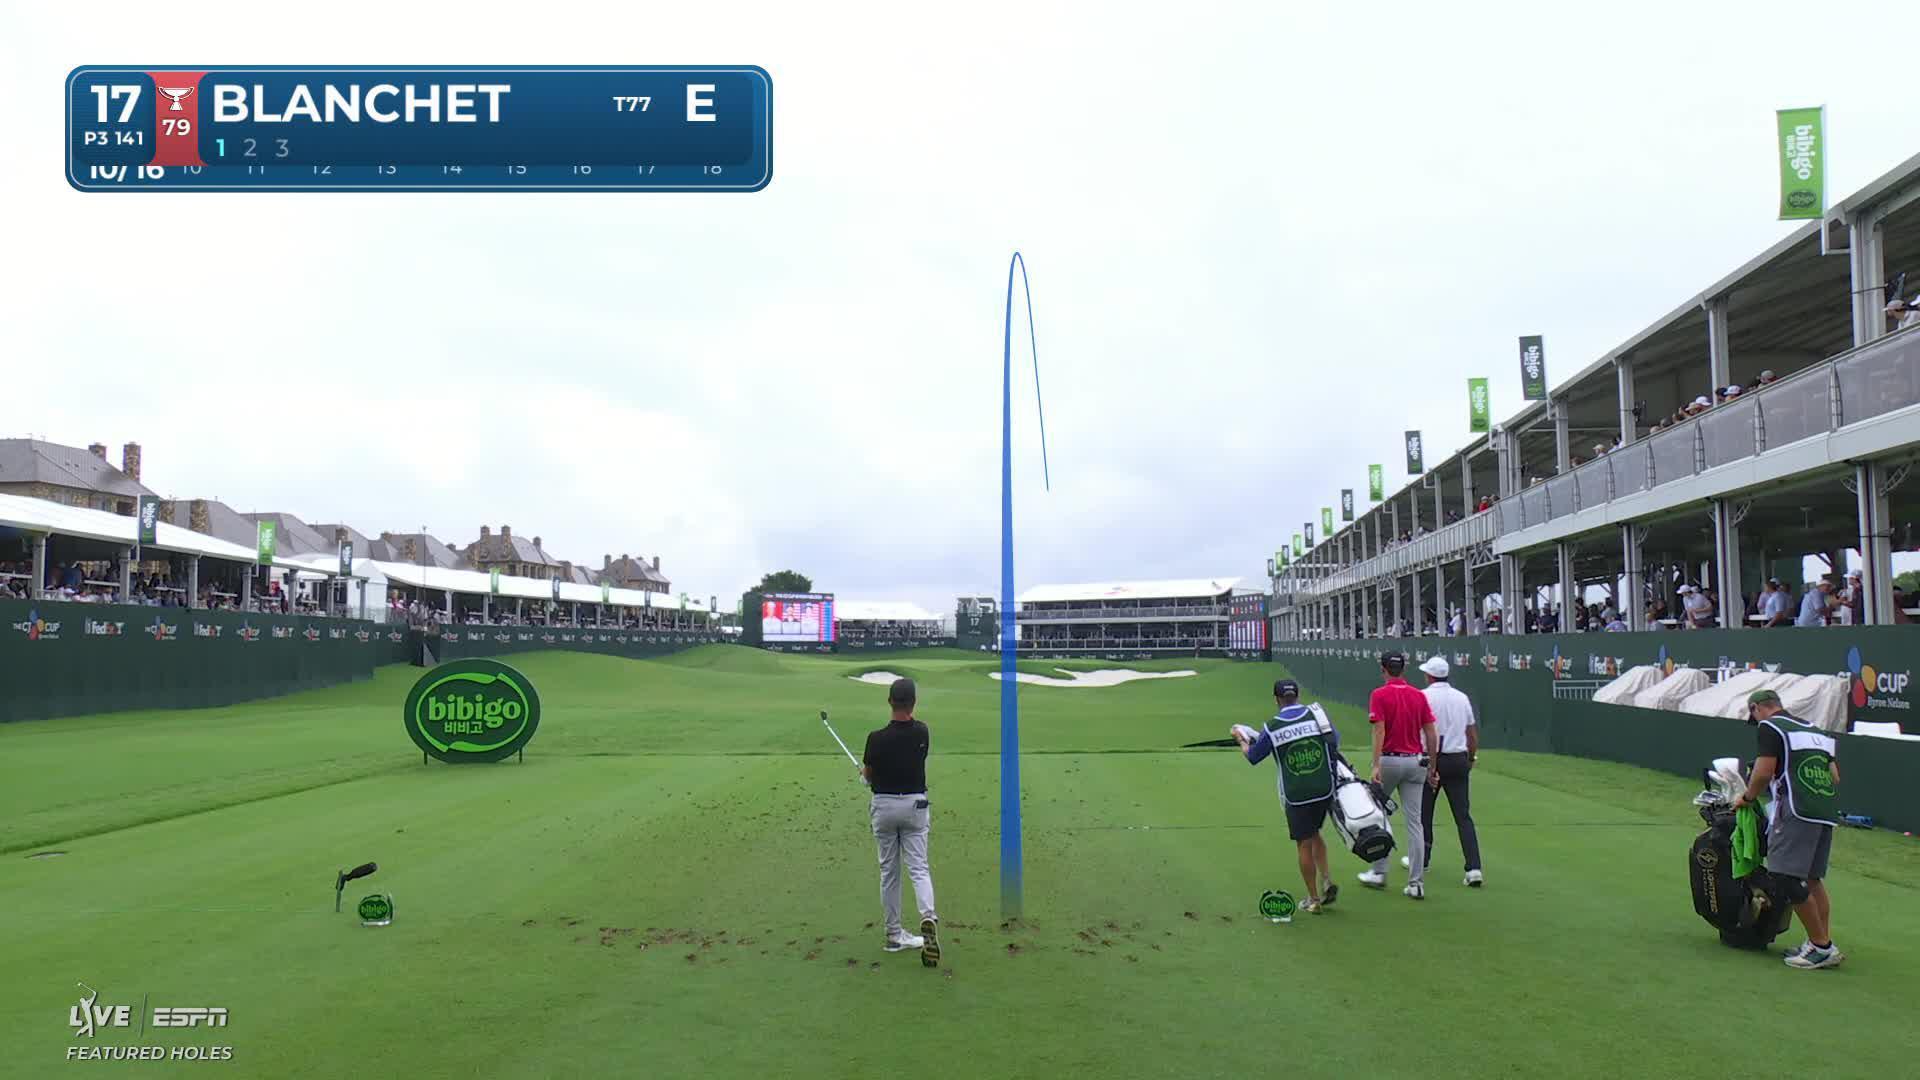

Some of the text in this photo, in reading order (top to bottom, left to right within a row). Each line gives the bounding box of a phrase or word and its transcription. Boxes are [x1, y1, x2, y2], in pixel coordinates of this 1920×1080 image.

[1791, 124, 1816, 180] bibigo
[1527, 345, 1541, 379] bibigo
[44, 621, 60, 633] CUP
[1876, 672, 1908, 693] CUP
[428, 693, 521, 729] bibigo
[443, 721, 484, 734] 비비고
